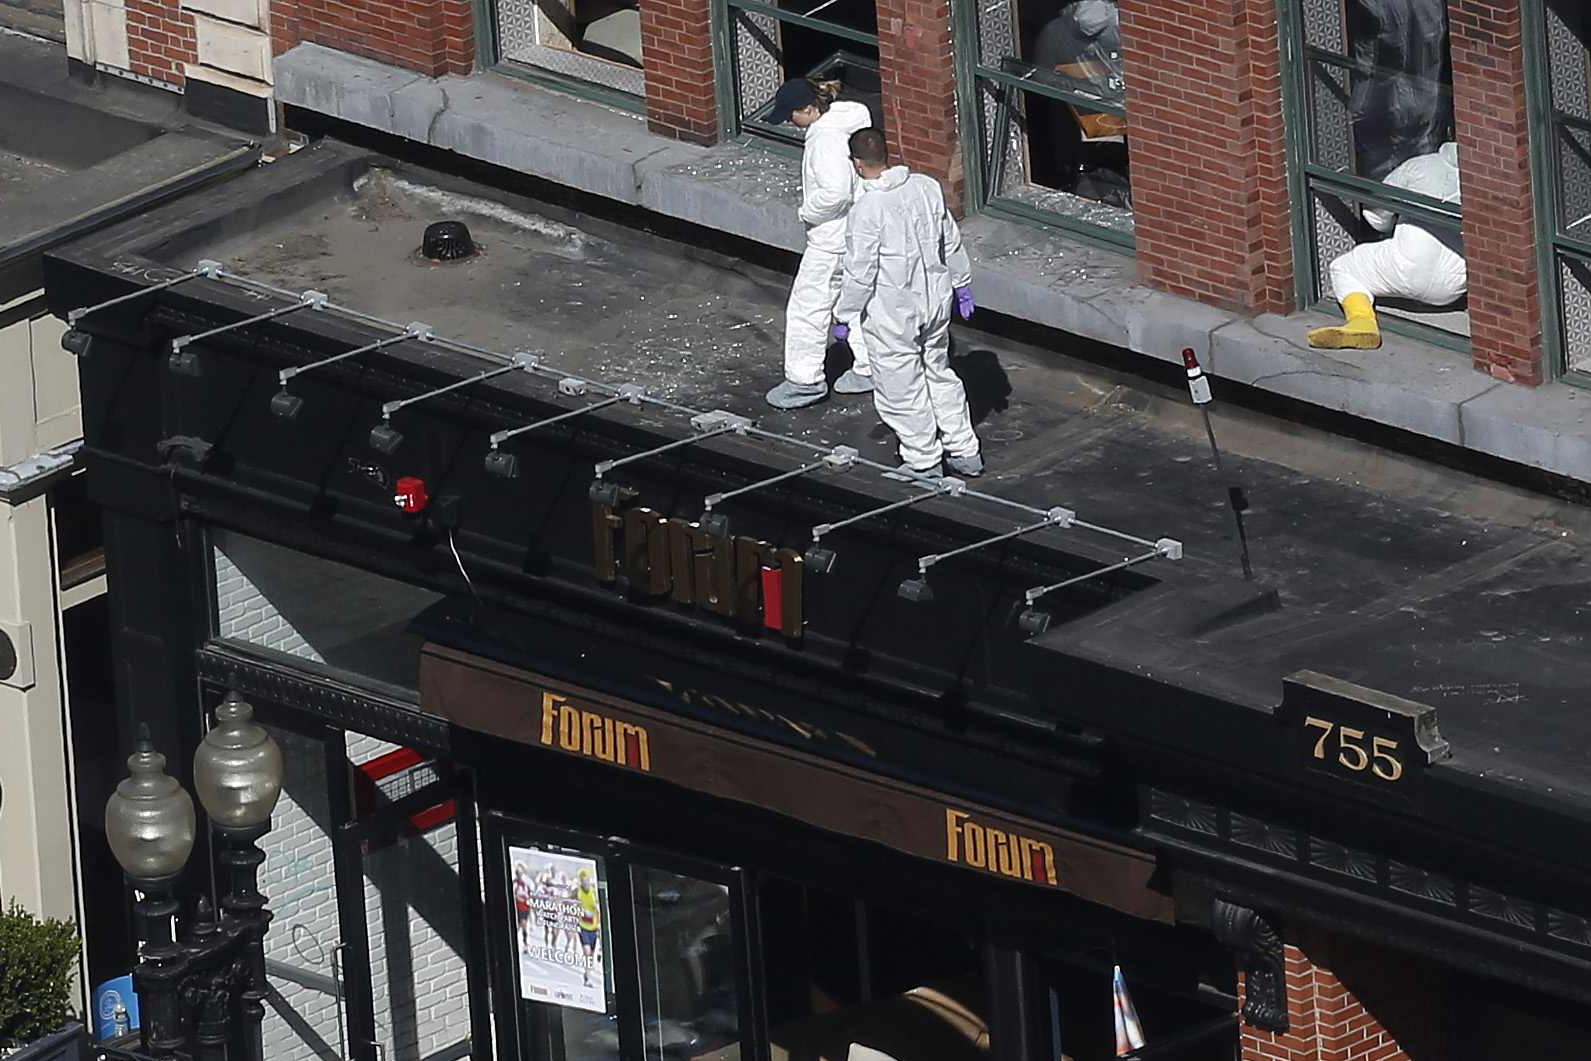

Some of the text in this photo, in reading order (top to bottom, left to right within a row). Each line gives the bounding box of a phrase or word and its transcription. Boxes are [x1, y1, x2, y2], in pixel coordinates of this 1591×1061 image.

[540, 691, 650, 771] Forum
[1304, 716, 1403, 782] 755
[946, 808, 1058, 885] Forum
[527, 943, 595, 970] WELCOME
